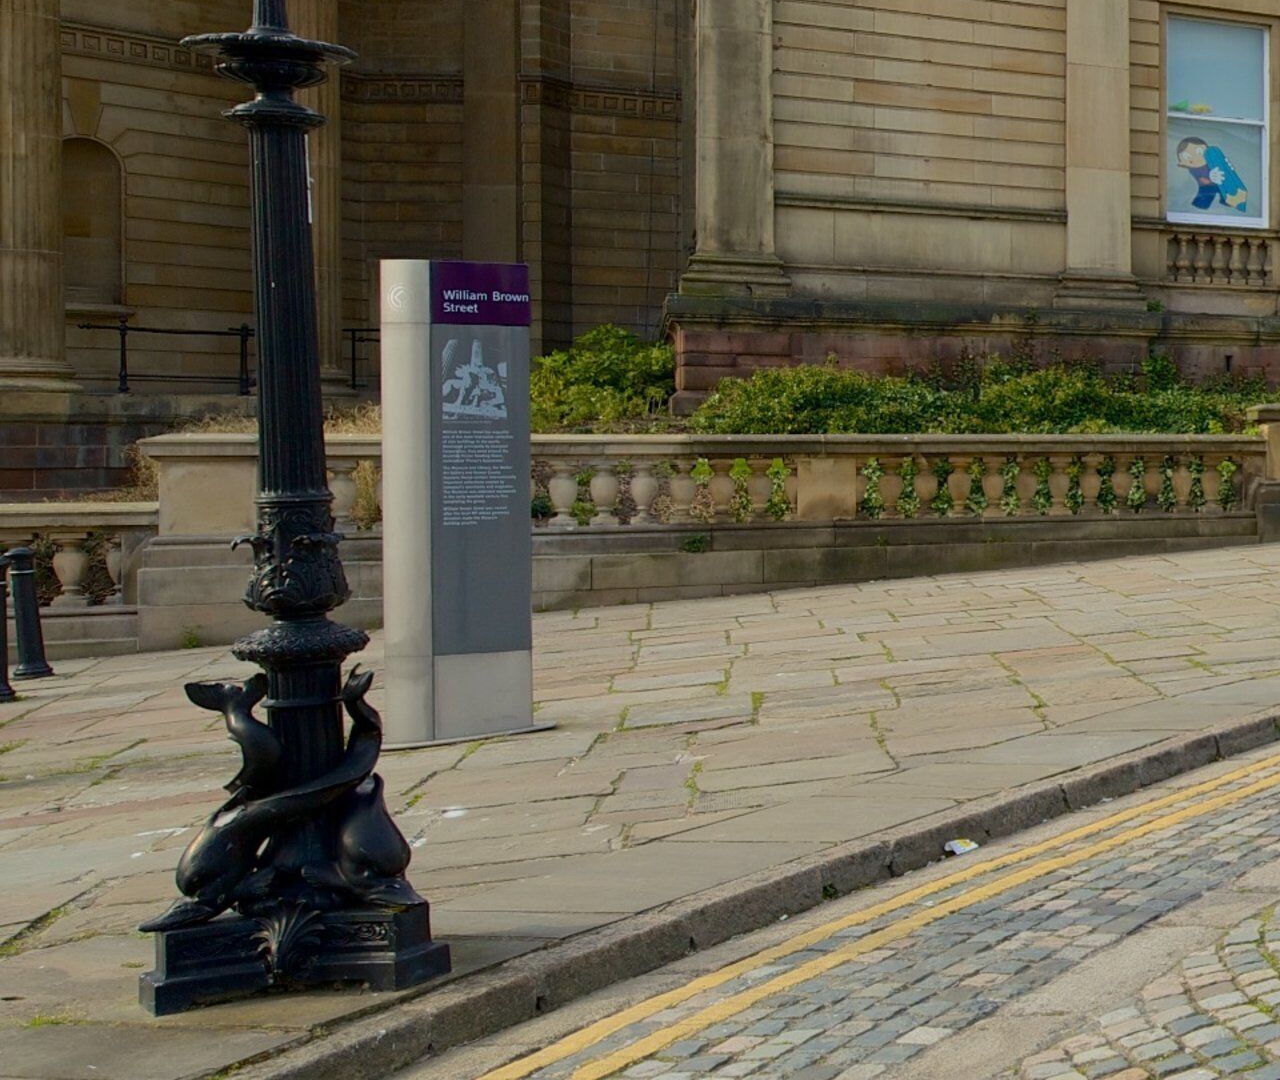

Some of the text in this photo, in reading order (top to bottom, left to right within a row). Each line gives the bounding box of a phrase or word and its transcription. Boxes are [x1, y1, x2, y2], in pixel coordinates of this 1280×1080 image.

[443, 290, 529, 302] William Brown
[443, 302, 479, 313] Street
